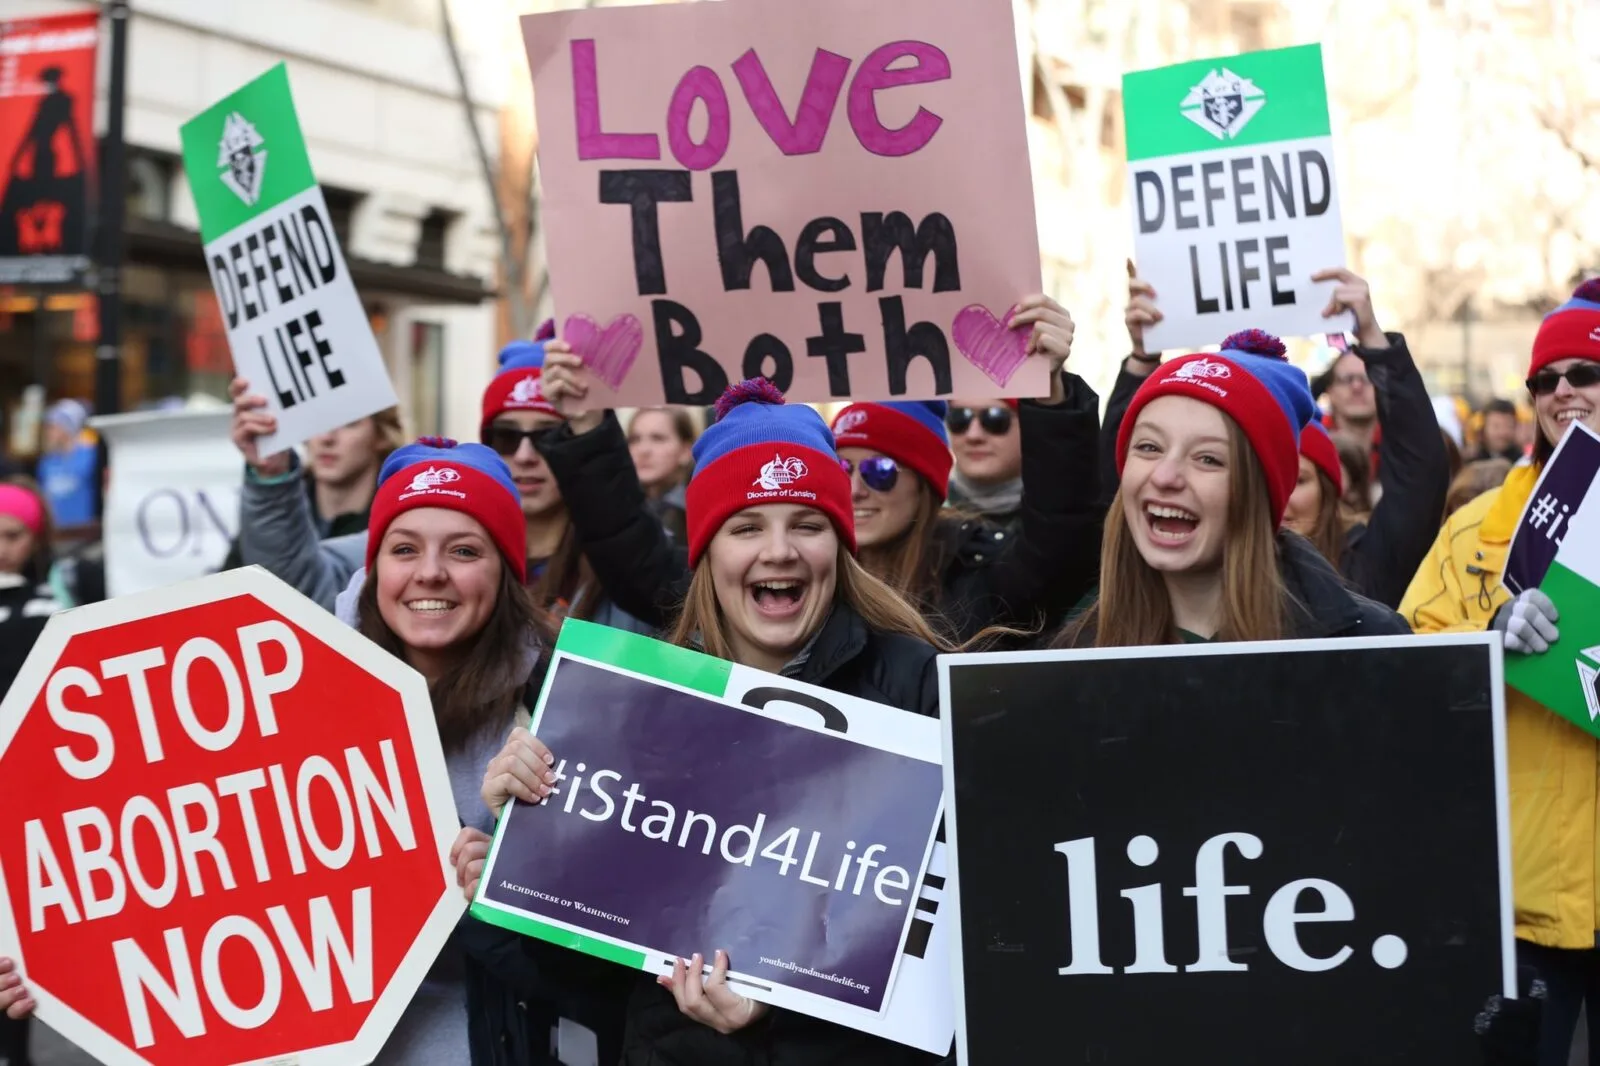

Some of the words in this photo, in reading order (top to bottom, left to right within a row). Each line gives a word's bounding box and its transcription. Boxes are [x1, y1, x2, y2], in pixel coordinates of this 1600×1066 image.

[570, 39, 952, 171] Love
[599, 169, 962, 296] Them
[1134, 149, 1332, 234] DEFEND
[212, 204, 337, 330] DEFEND
[1189, 234, 1296, 315] LIFE
[258, 309, 347, 410] LIFE
[651, 295, 953, 406] Both
[1196, 379, 1228, 398] Lansing
[436, 488, 467, 499] Lansing
[747, 491, 778, 500] Diocese
[788, 489, 817, 500] Lansing
[45, 619, 304, 780] STOP
[23, 738, 418, 934] ABORTION
[1053, 831, 1409, 976] life.
[111, 886, 375, 1049] NOW
[758, 955, 872, 995] youthrallyandmassforlife.org
